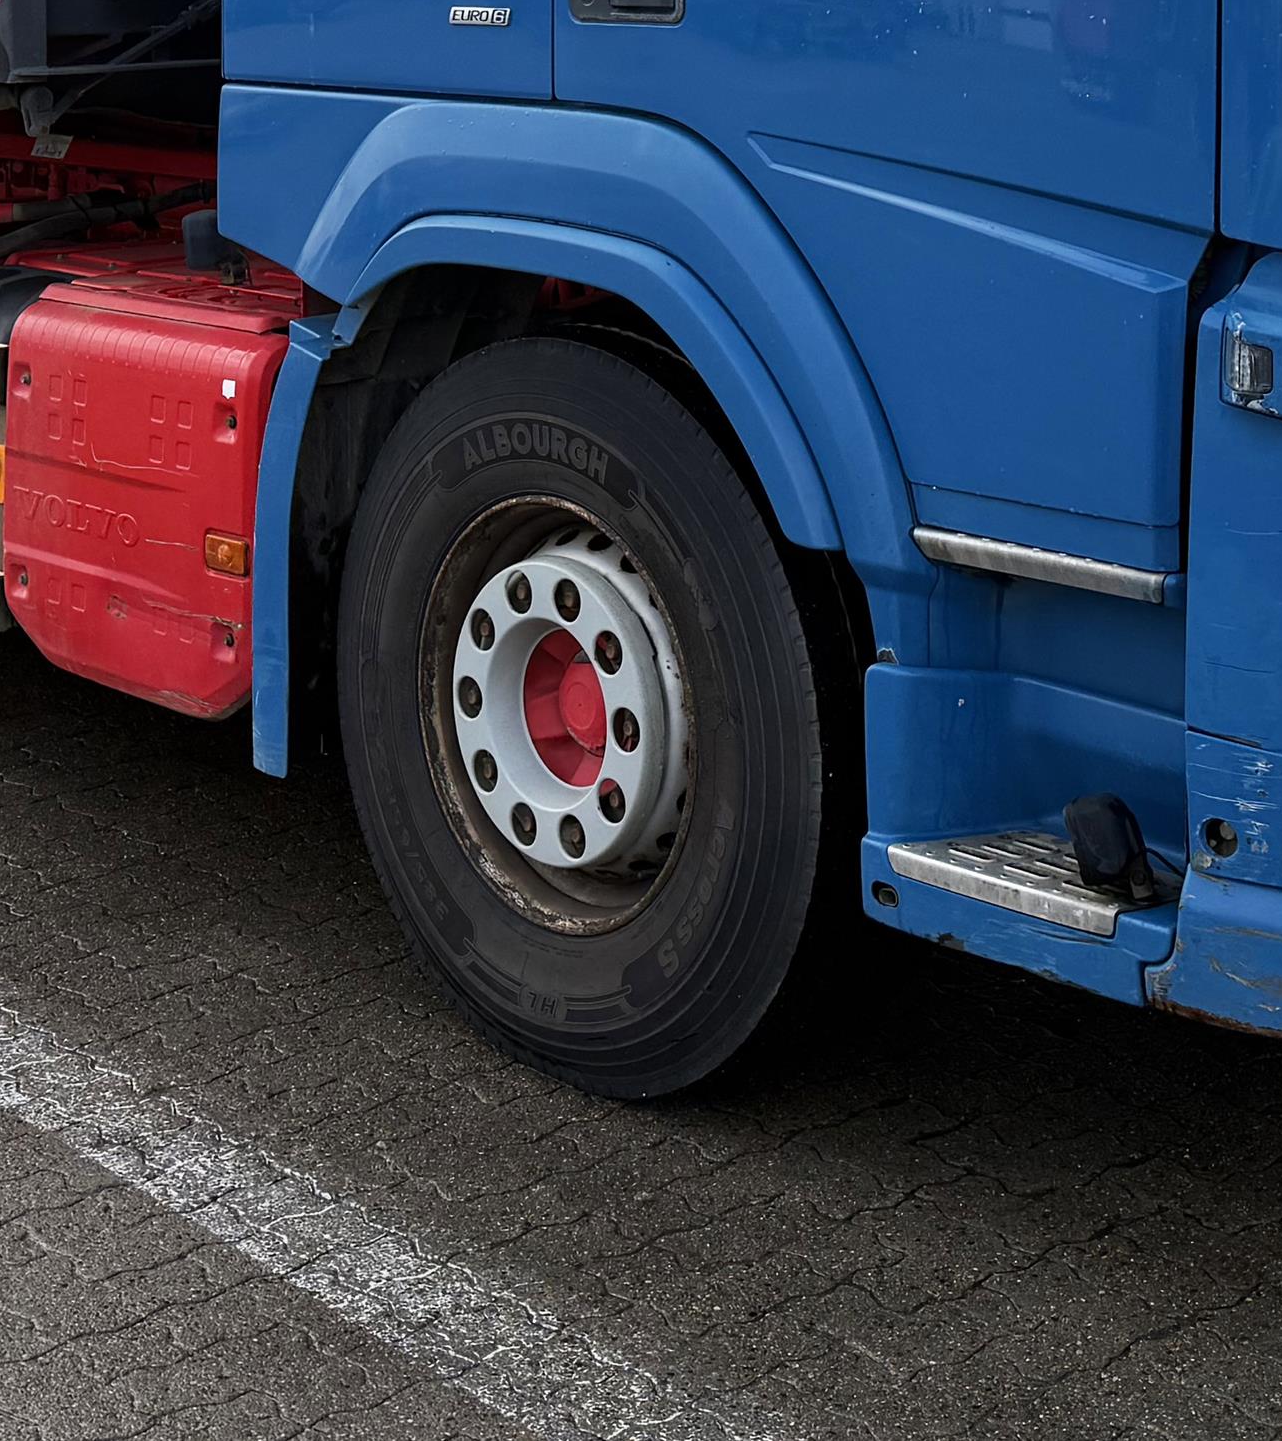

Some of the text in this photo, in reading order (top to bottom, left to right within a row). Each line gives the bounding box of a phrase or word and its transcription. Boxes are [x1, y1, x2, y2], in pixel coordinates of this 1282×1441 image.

[451, 8, 489, 23] EURO
[462, 423, 608, 484] ALBOURGH
[13, 485, 140, 548] VOLVO
